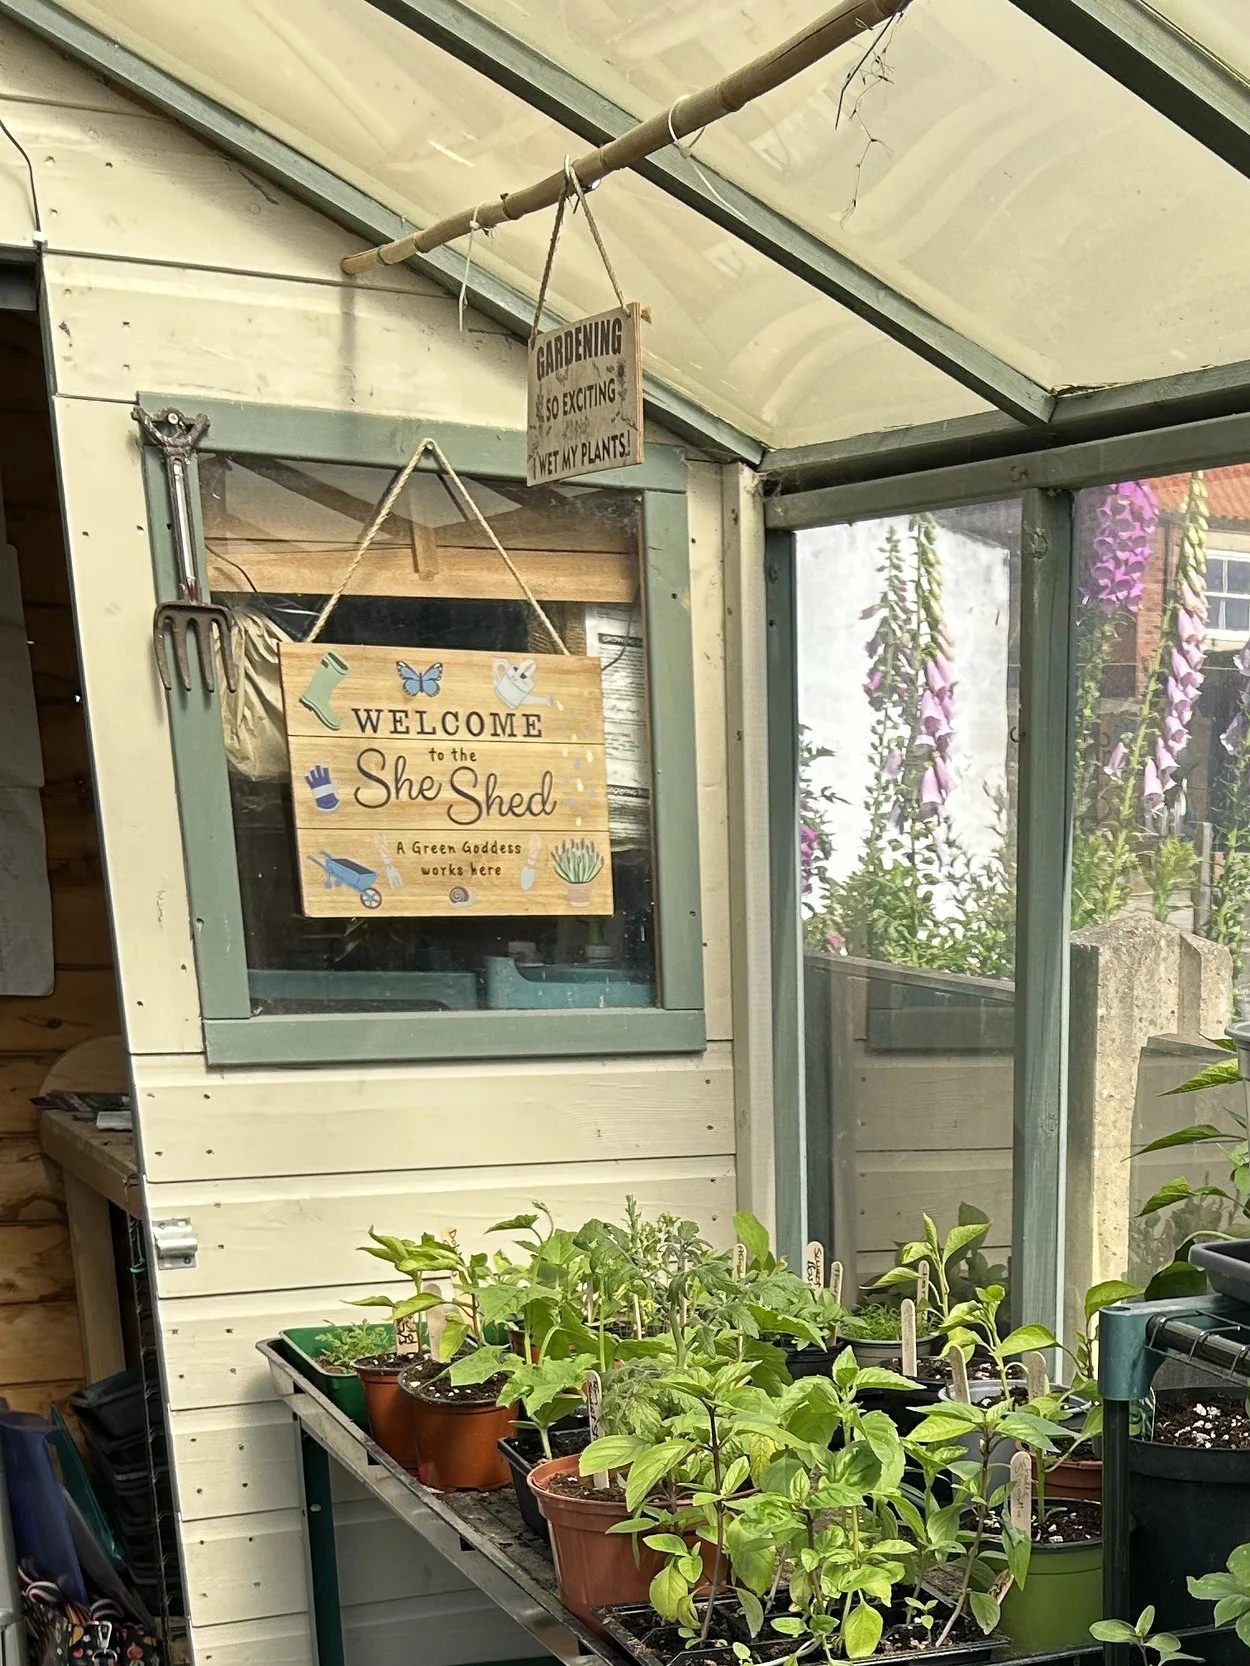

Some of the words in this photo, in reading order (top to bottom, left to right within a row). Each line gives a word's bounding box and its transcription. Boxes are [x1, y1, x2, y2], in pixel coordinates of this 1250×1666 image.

[536, 317, 623, 382] GARDENING
[545, 394, 560, 423] SO
[562, 377, 616, 417] EXCITING
[532, 458, 538, 481] I
[538, 451, 560, 475] WET
[562, 444, 579, 472] MY
[581, 429, 632, 466] PLANTS!
[351, 707, 543, 739] WELCOME
[428, 747, 445, 762] to
[451, 747, 478, 763] the
[353, 747, 442, 810] She
[447, 765, 558, 826] Shed
[396, 841, 406, 855] A
[411, 841, 457, 856] Green
[461, 841, 523, 856] Goddess
[420, 863, 464, 877] works
[469, 863, 502, 877] here
